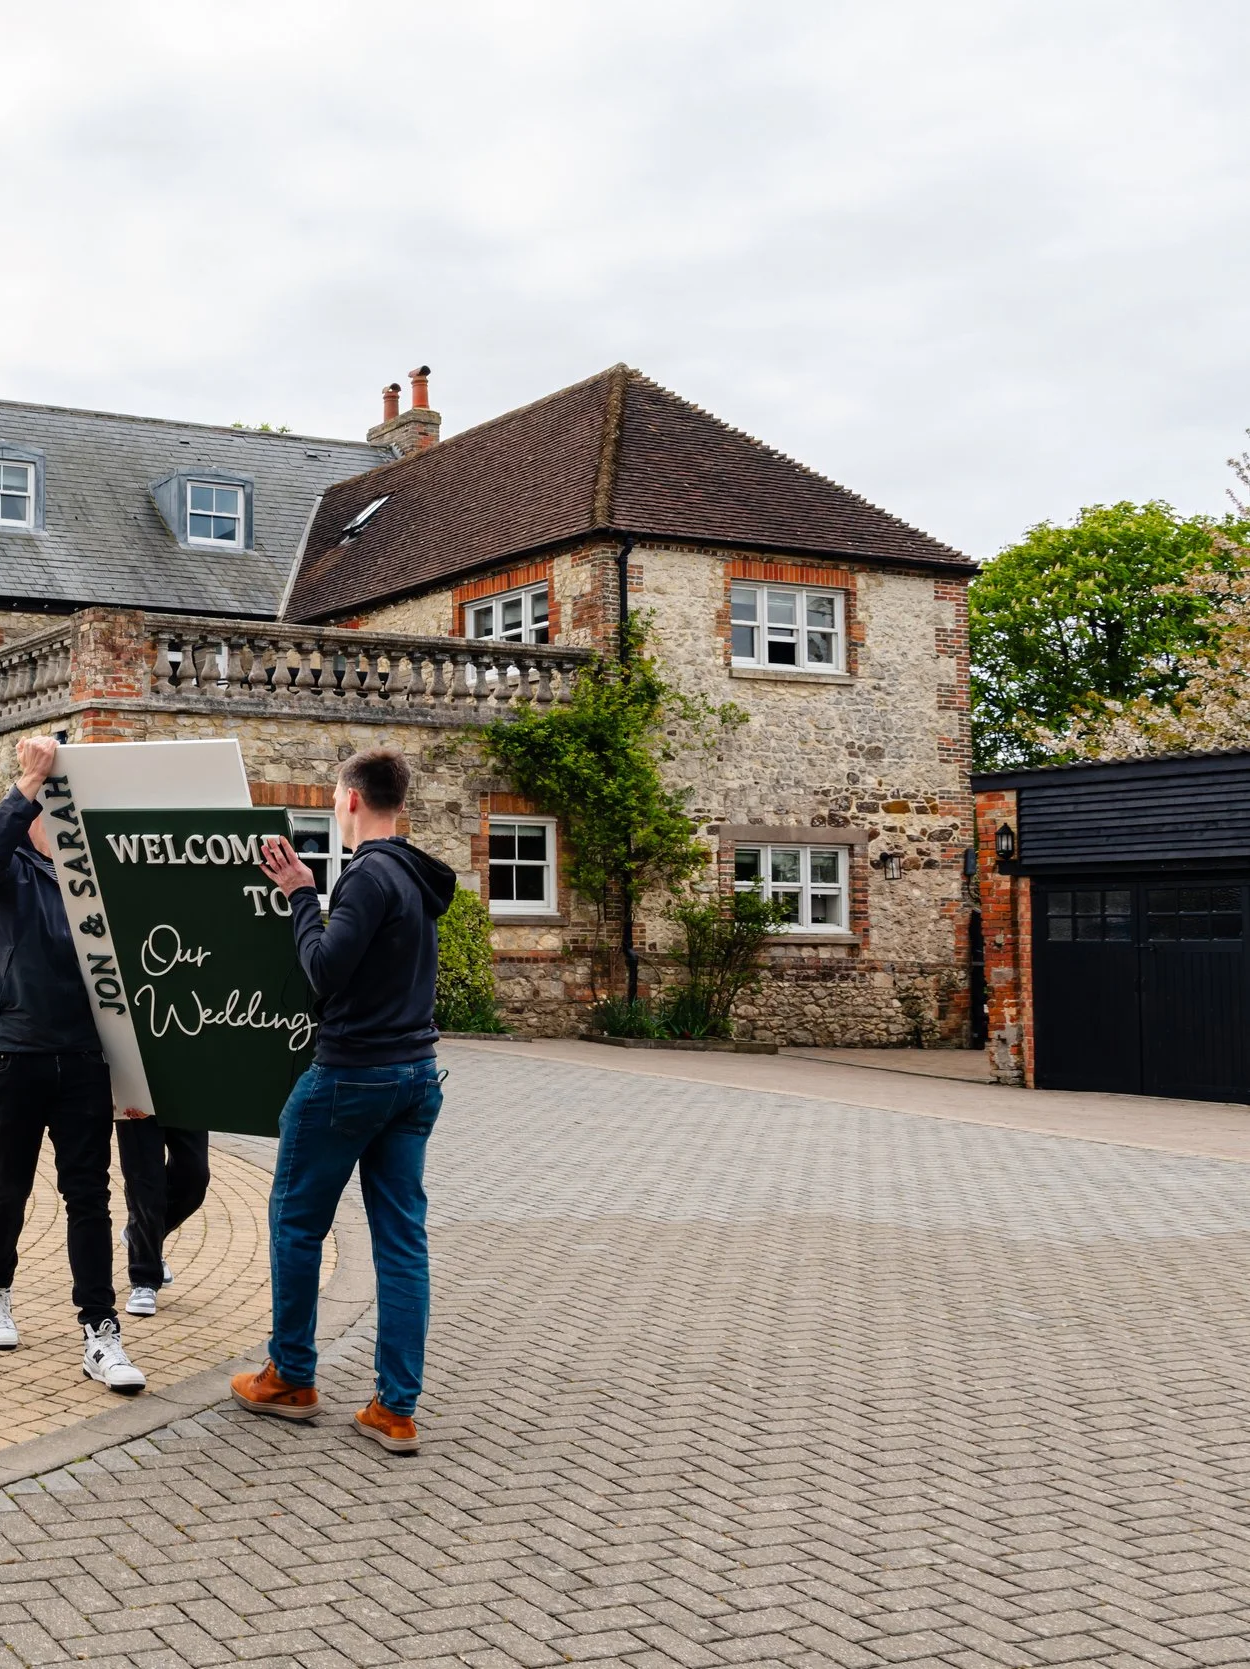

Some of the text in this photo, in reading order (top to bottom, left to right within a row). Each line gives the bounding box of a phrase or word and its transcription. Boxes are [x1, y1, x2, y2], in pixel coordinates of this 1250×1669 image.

[42, 775, 126, 1015] JON & SARAH
[243, 886, 293, 916] TO
[141, 924, 211, 976] Our
[134, 984, 318, 1051] Wedding
